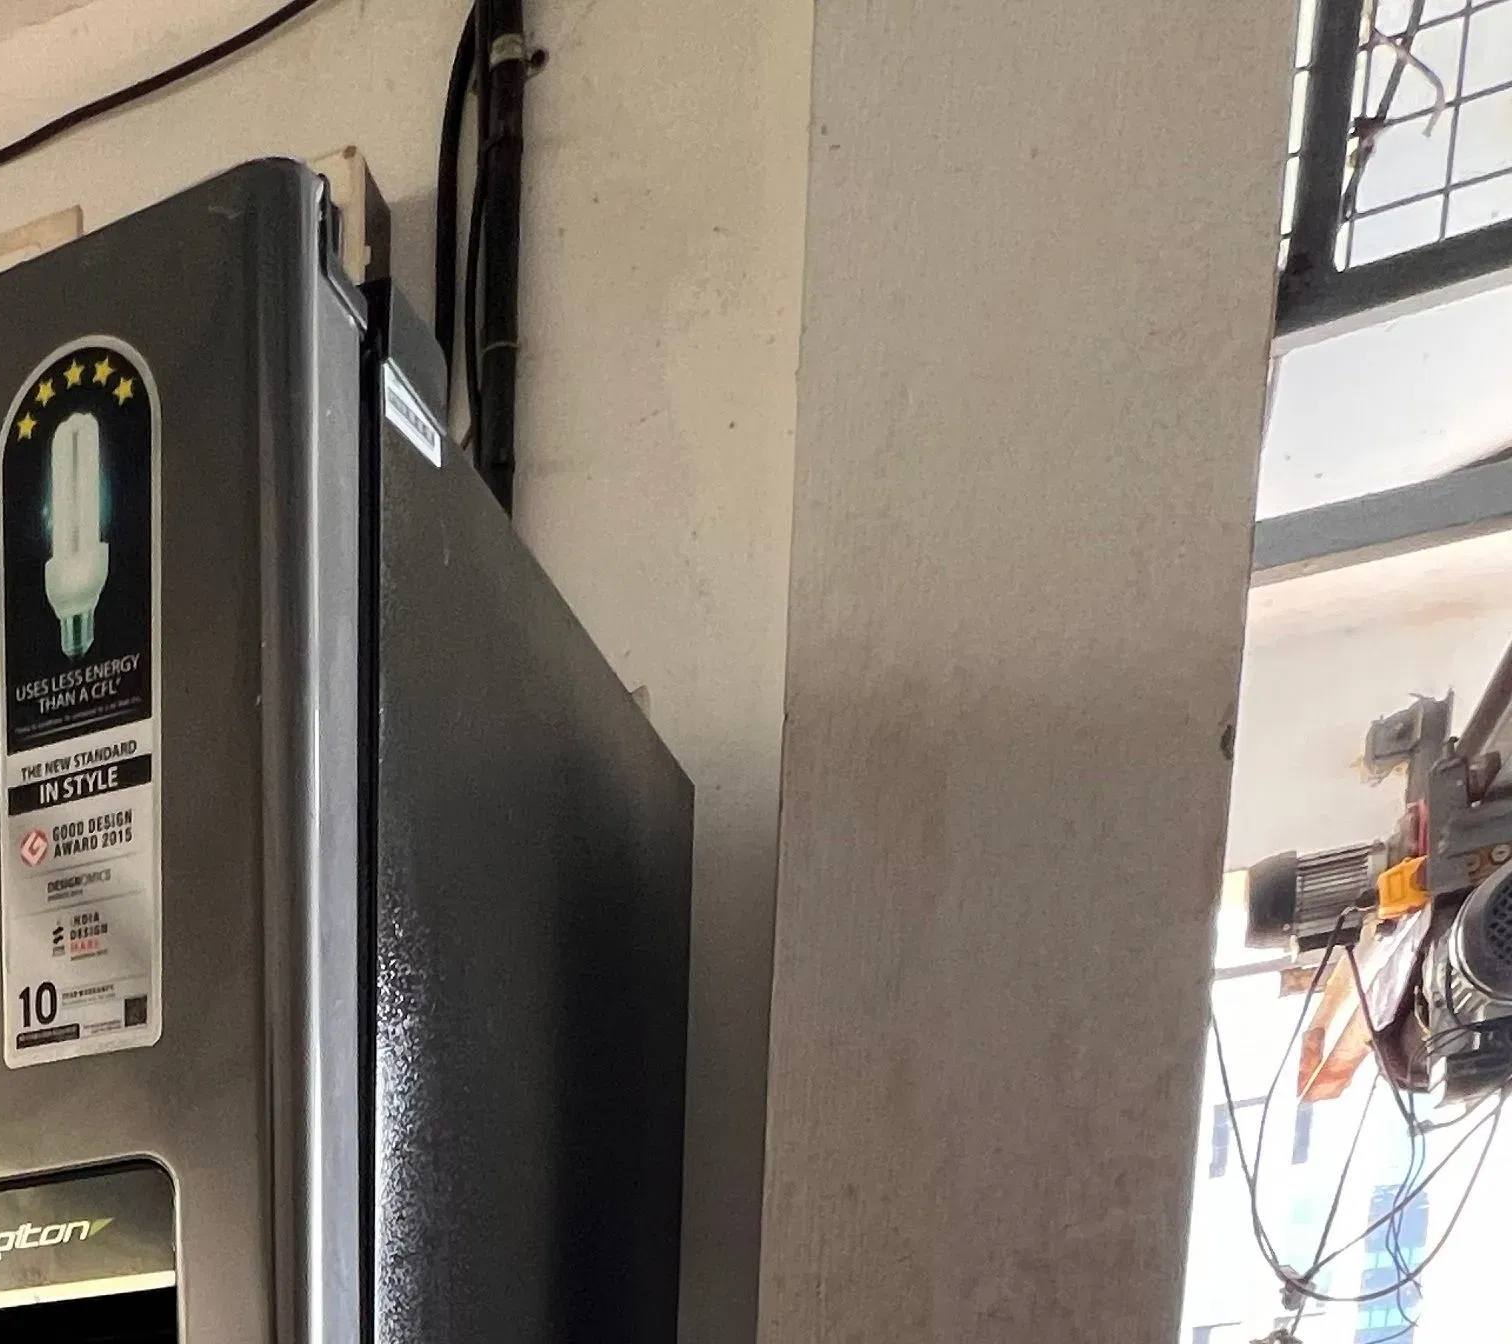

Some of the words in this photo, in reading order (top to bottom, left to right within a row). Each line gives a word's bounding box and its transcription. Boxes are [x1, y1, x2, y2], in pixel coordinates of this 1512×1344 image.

[16, 678, 49, 702] USES
[51, 668, 83, 692] LESS
[85, 653, 140, 683] ENERGY
[39, 691, 76, 715] THAN
[79, 688, 88, 703] A
[21, 763, 42, 782] THE
[45, 757, 71, 774] NEW
[74, 739, 137, 768] STANDARD
[40, 780, 58, 804] IN
[63, 765, 119, 798] STYLE
[52, 821, 84, 842] GOOD
[88, 808, 132, 834] DESIGN
[53, 834, 88, 860] AWARD
[102, 827, 133, 849] 2015
[18, 981, 58, 1028] 10
